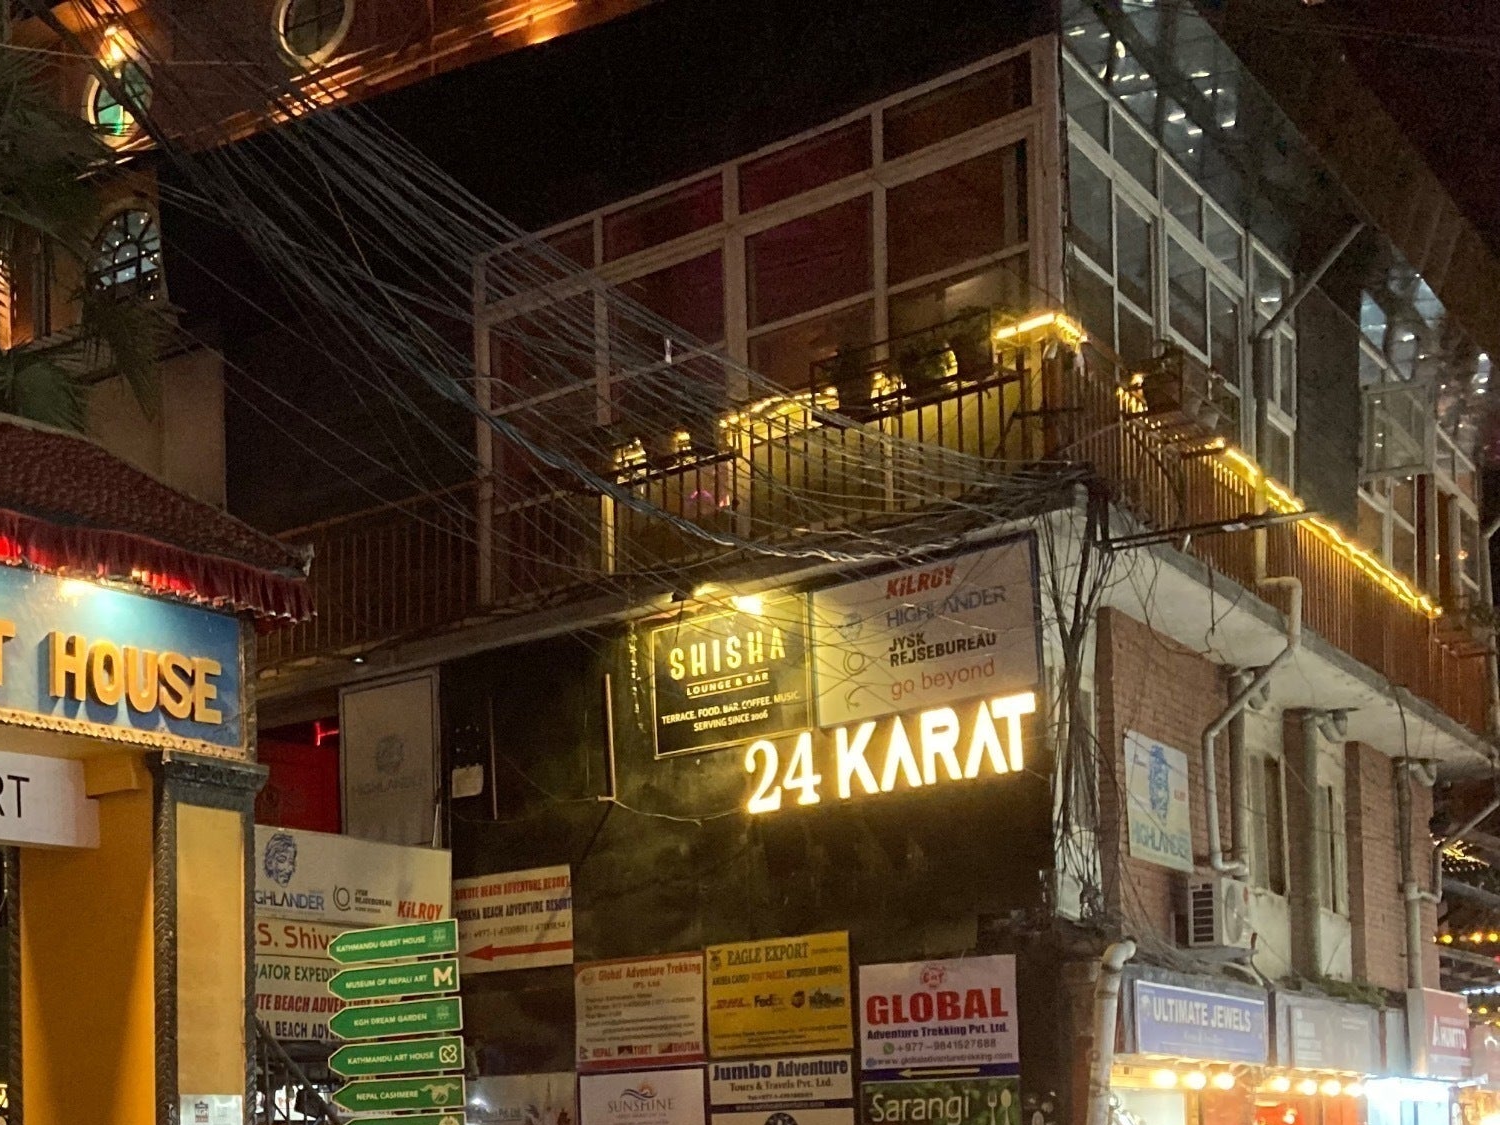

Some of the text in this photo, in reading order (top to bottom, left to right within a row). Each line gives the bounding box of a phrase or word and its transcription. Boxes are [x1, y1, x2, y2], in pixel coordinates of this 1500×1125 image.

[886, 585, 1007, 628] HIGHLANDER
[889, 631, 925, 652] JYSK
[890, 632, 997, 667] REJSEBUREAU
[669, 627, 786, 681] SHISHA
[49, 630, 223, 725] HOUSE
[687, 672, 769, 696] LOUNGE & BAR
[891, 657, 996, 701] go beyond
[694, 709, 769, 732] SERVING SINCE 2006
[744, 692, 1035, 814] 24 KARAT
[284, 925, 336, 950] Shiv
[336, 935, 426, 953] KATHMANDU GUEST HOUSE
[727, 947, 761, 966] EAGLE
[765, 942, 809, 962] EXPORT
[345, 979, 375, 989] MUSEUM
[377, 978, 387, 987] OF
[388, 976, 412, 986] NEPALI
[414, 974, 428, 983] ART
[273, 994, 310, 1013] BEACH
[866, 987, 1009, 1026] GLOBAL
[354, 1013, 428, 1027] KGH DREAM GARDEN
[1152, 998, 1251, 1033] ULTIMATE JEWELS
[276, 1021, 308, 1039] BEACH
[867, 1028, 919, 1040] Adventure
[921, 1026, 966, 1038] Trekking
[348, 1051, 434, 1065] KATHMANDU ART HOUSE
[713, 1060, 849, 1081] Jumbo Adventure
[356, 1090, 419, 1101] NEPAL CASHMERE
[730, 1082, 754, 1092] Tours
[765, 1079, 794, 1091] Travels
[608, 1097, 674, 1114] SUNSHINE
